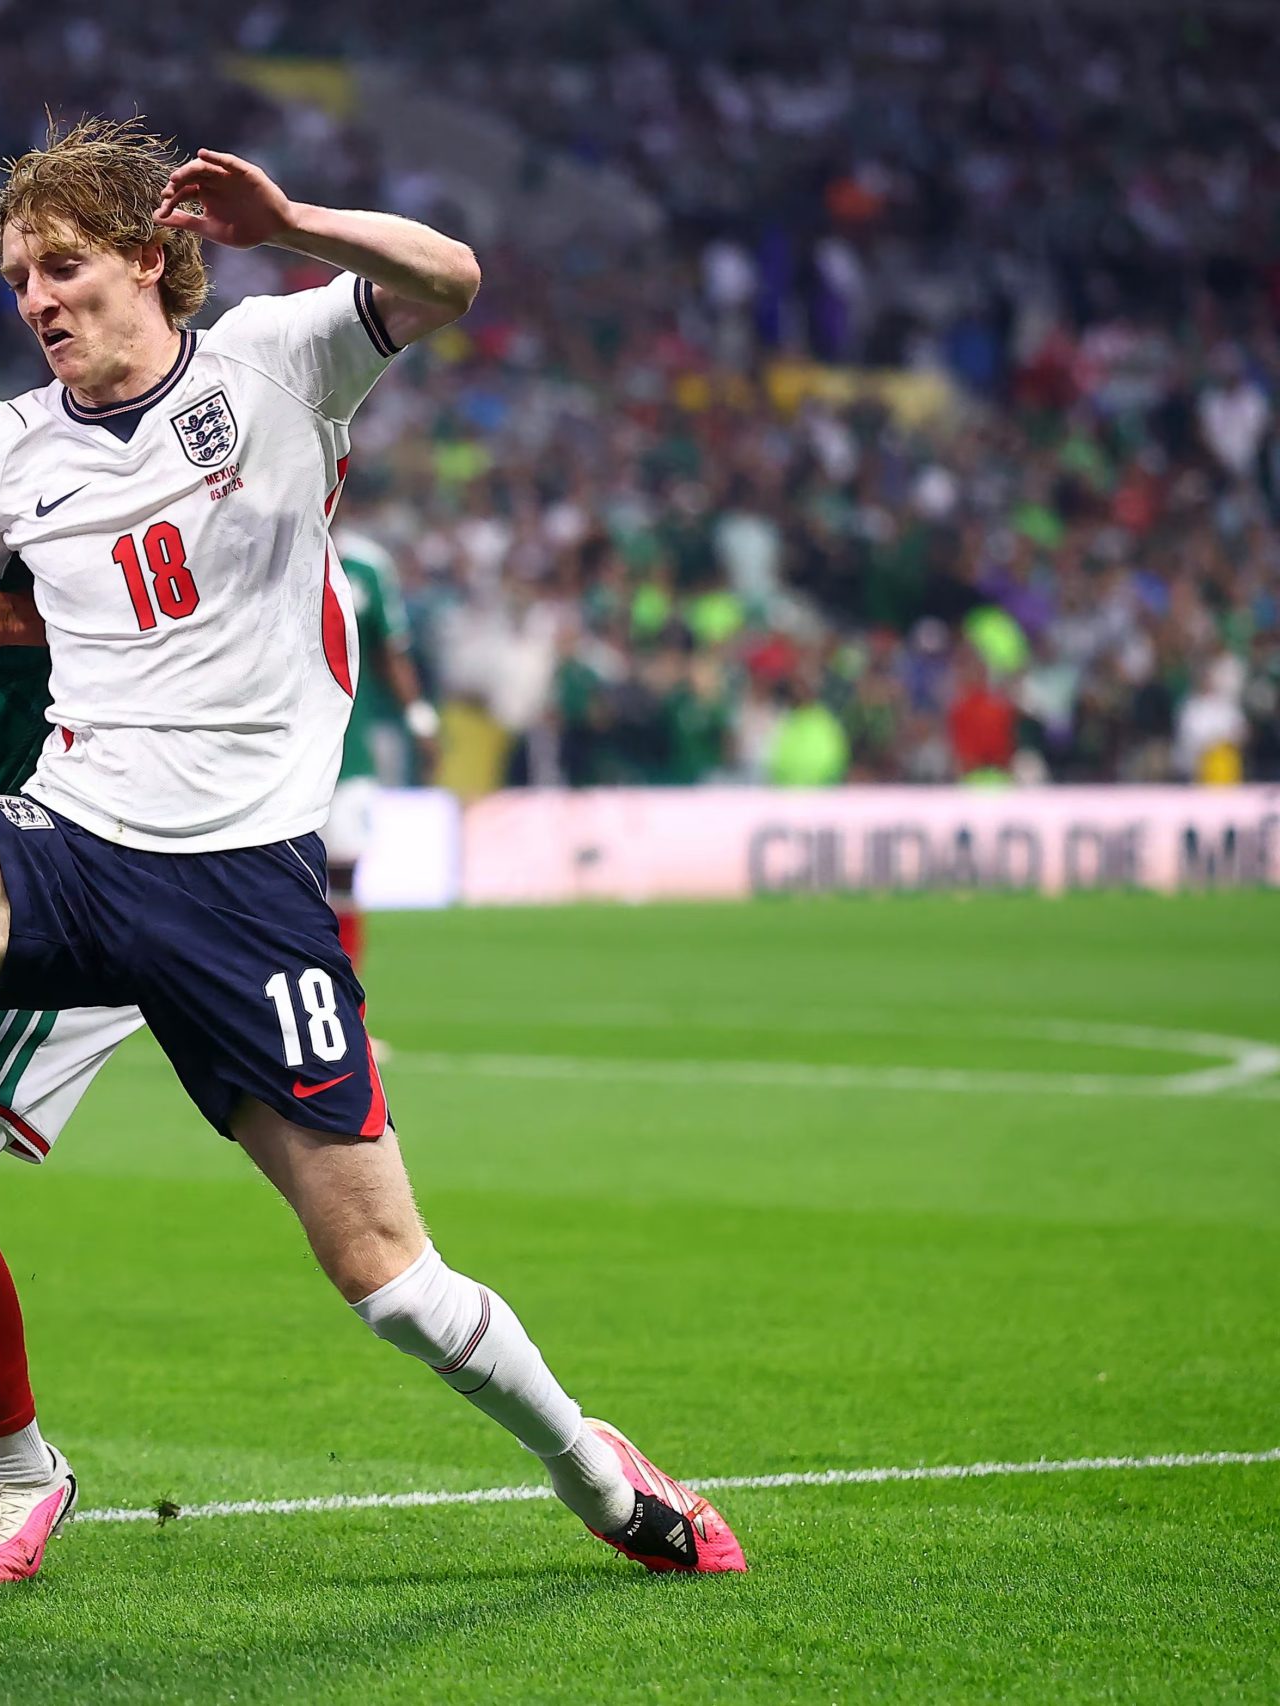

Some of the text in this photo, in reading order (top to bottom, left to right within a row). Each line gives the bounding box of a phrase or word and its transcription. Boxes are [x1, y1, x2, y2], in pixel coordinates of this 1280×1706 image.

[204, 462, 240, 486] MEXICO
[210, 477, 244, 501] 05.07.26
[112, 521, 200, 632] 18
[749, 822, 1044, 892] CIUDAD
[1064, 820, 1139, 890] DE
[263, 966, 349, 1068] 18
[635, 1503, 644, 1518] EST.
